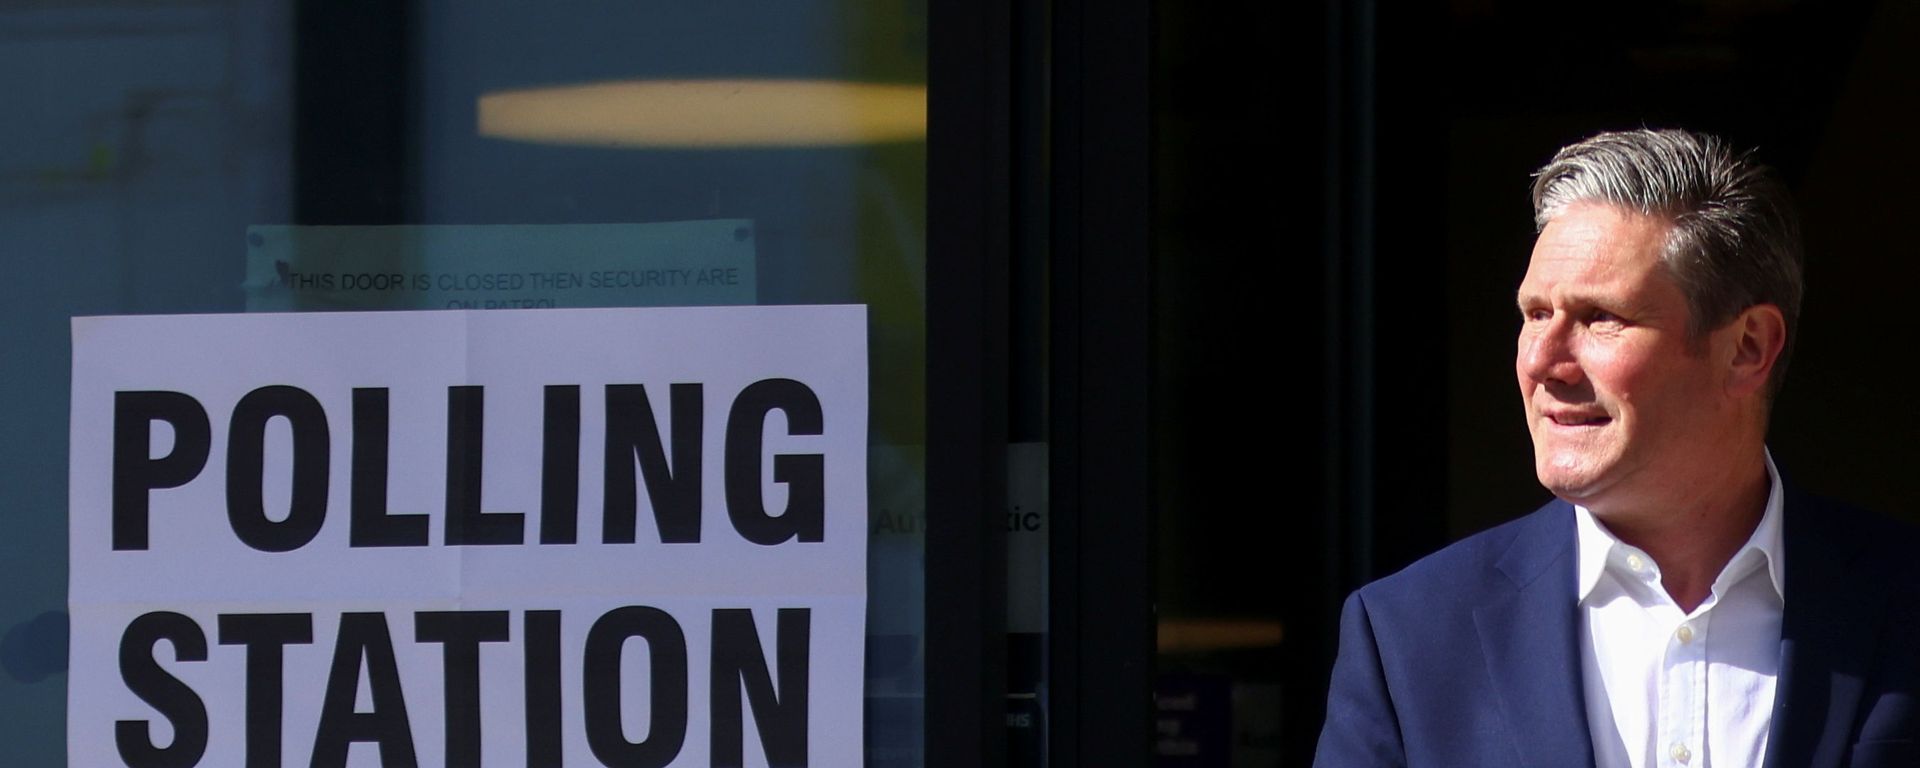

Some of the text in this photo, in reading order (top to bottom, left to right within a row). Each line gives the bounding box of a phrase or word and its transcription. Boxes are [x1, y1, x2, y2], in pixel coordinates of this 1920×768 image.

[342, 273, 404, 290] DOOR
[412, 273, 431, 290] IS
[438, 273, 523, 291] CLOSED
[530, 271, 583, 290] THEN
[590, 269, 692, 289] SECURITY
[697, 267, 739, 286] ARE
[112, 378, 825, 552] POLLING
[115, 606, 812, 768] STATION
